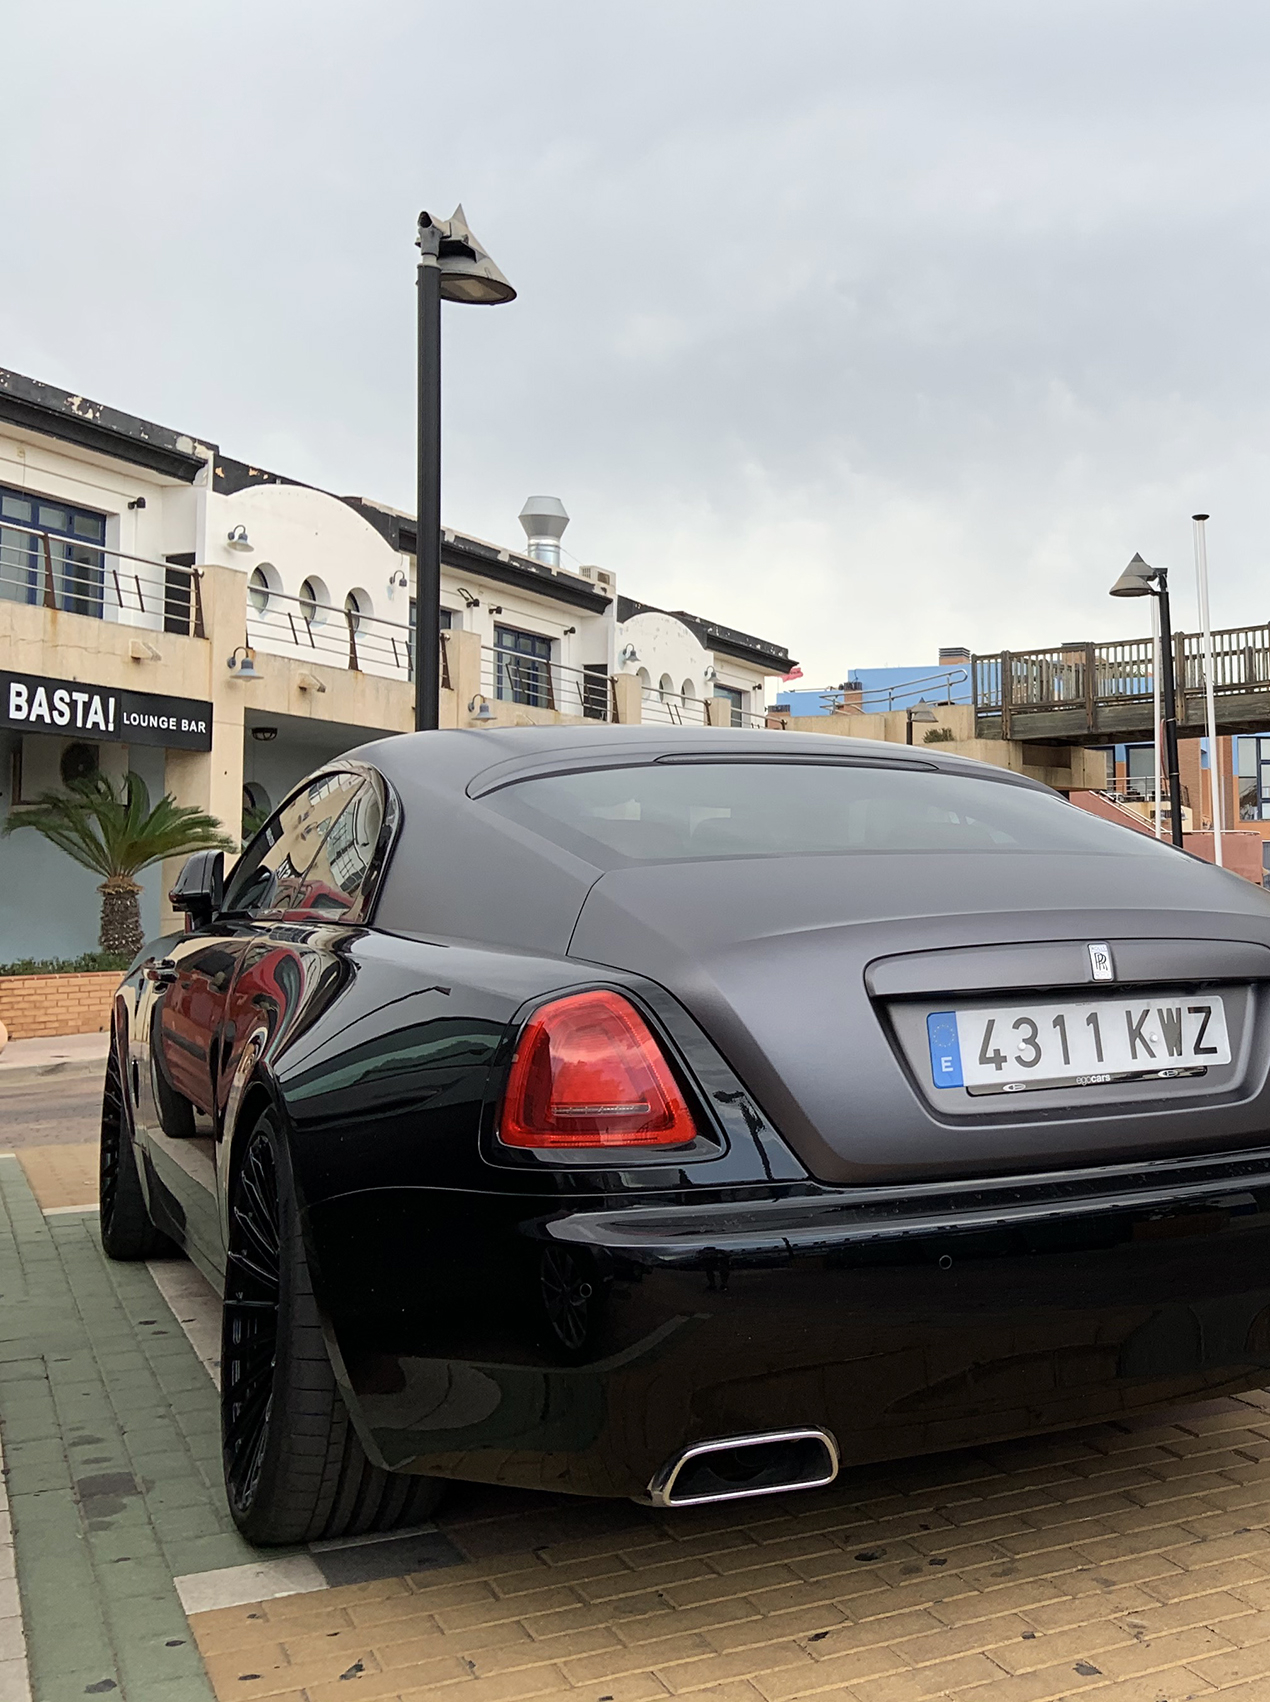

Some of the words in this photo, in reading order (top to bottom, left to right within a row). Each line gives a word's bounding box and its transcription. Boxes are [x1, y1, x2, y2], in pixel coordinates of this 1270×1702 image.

[9, 682, 115, 732] BASTA!
[123, 712, 177, 730] LOUNGE
[181, 719, 206, 734] BAR
[978, 1011, 1104, 1071] 4311
[1124, 1005, 1218, 1060] KWZ
[941, 1056, 953, 1072] E
